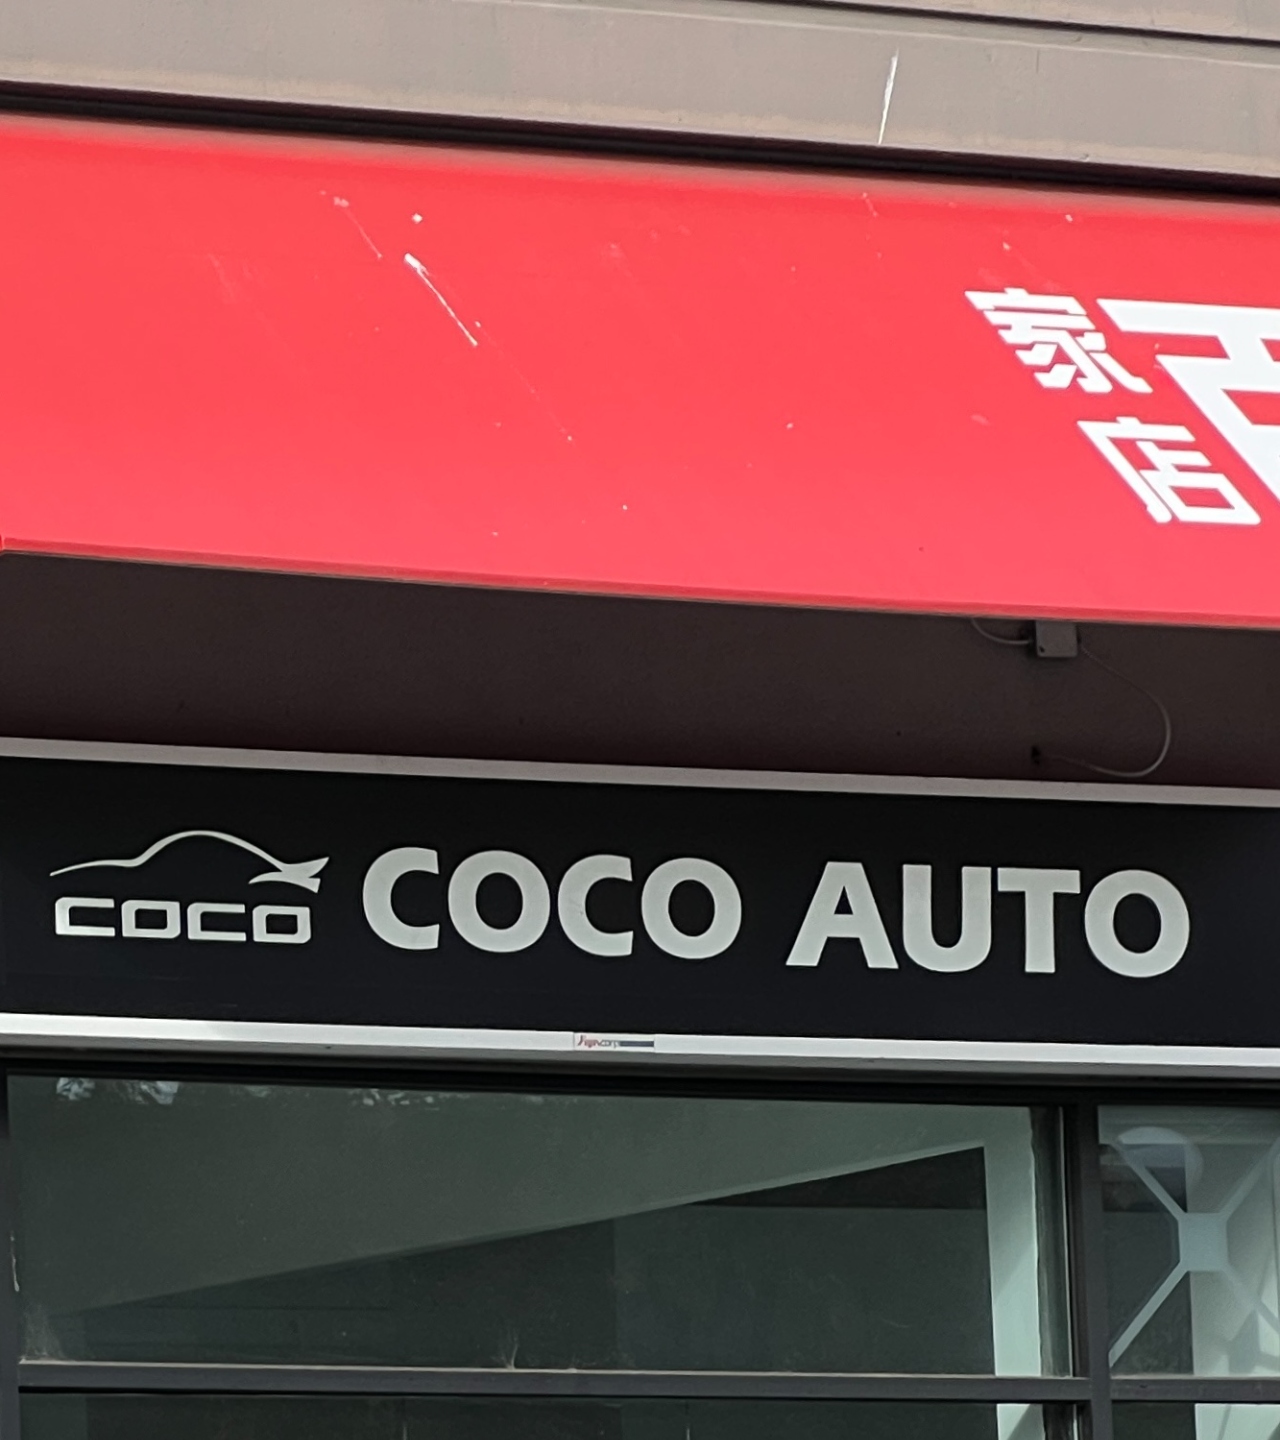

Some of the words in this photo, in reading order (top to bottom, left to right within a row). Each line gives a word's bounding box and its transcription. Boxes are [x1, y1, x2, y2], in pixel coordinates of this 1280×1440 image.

[53, 895, 313, 945] COCO
[362, 846, 743, 961] COCO
[785, 861, 1191, 979] AUTO
